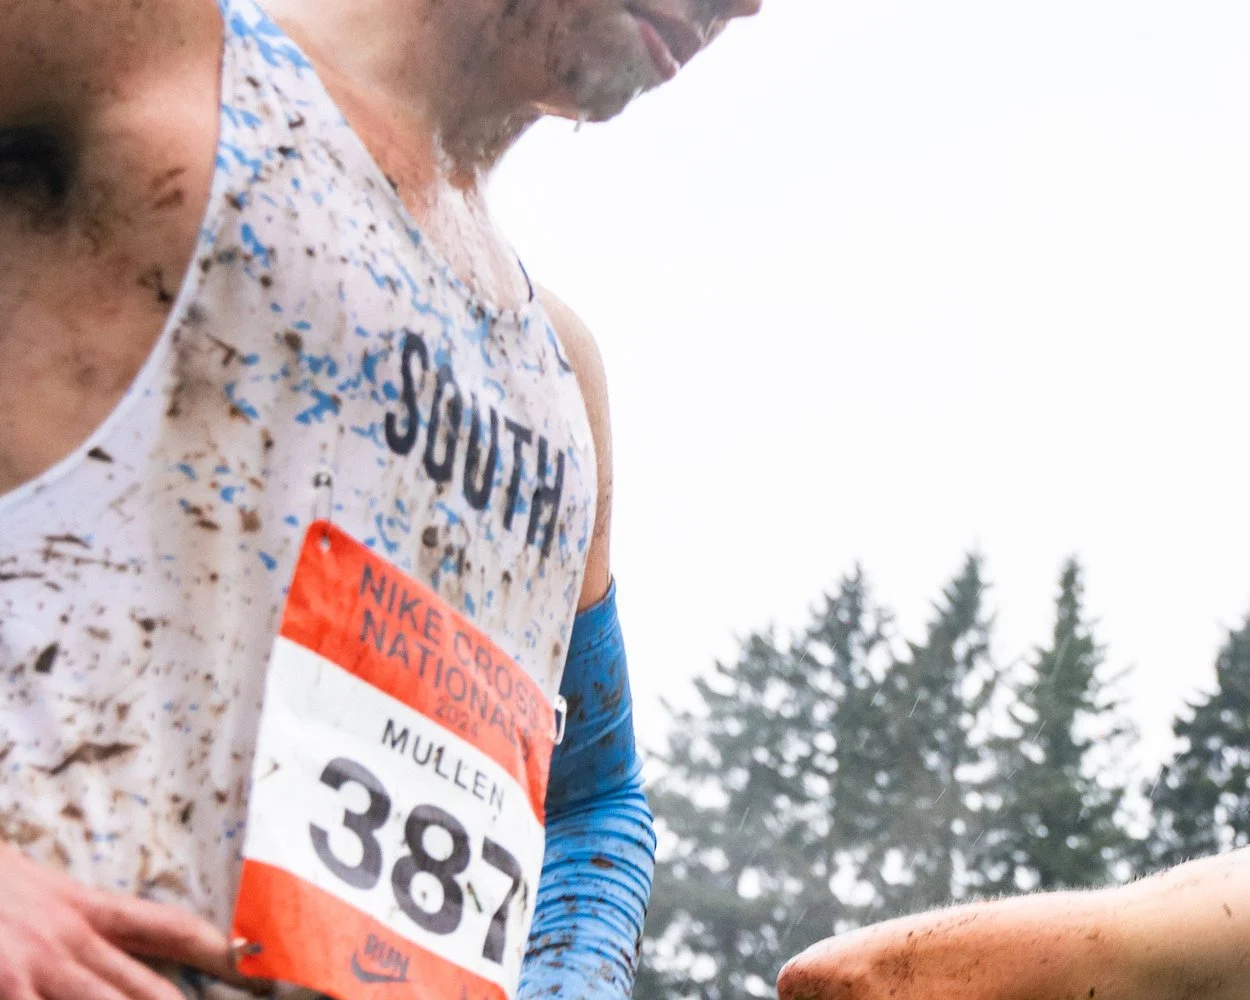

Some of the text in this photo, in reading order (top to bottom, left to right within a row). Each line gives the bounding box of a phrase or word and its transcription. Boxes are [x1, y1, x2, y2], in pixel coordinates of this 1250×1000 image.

[385, 329, 565, 558] SOUTH
[360, 564, 540, 730] NIKE CROSS
[381, 718, 505, 815] MULLEN
[309, 757, 522, 966] 387
